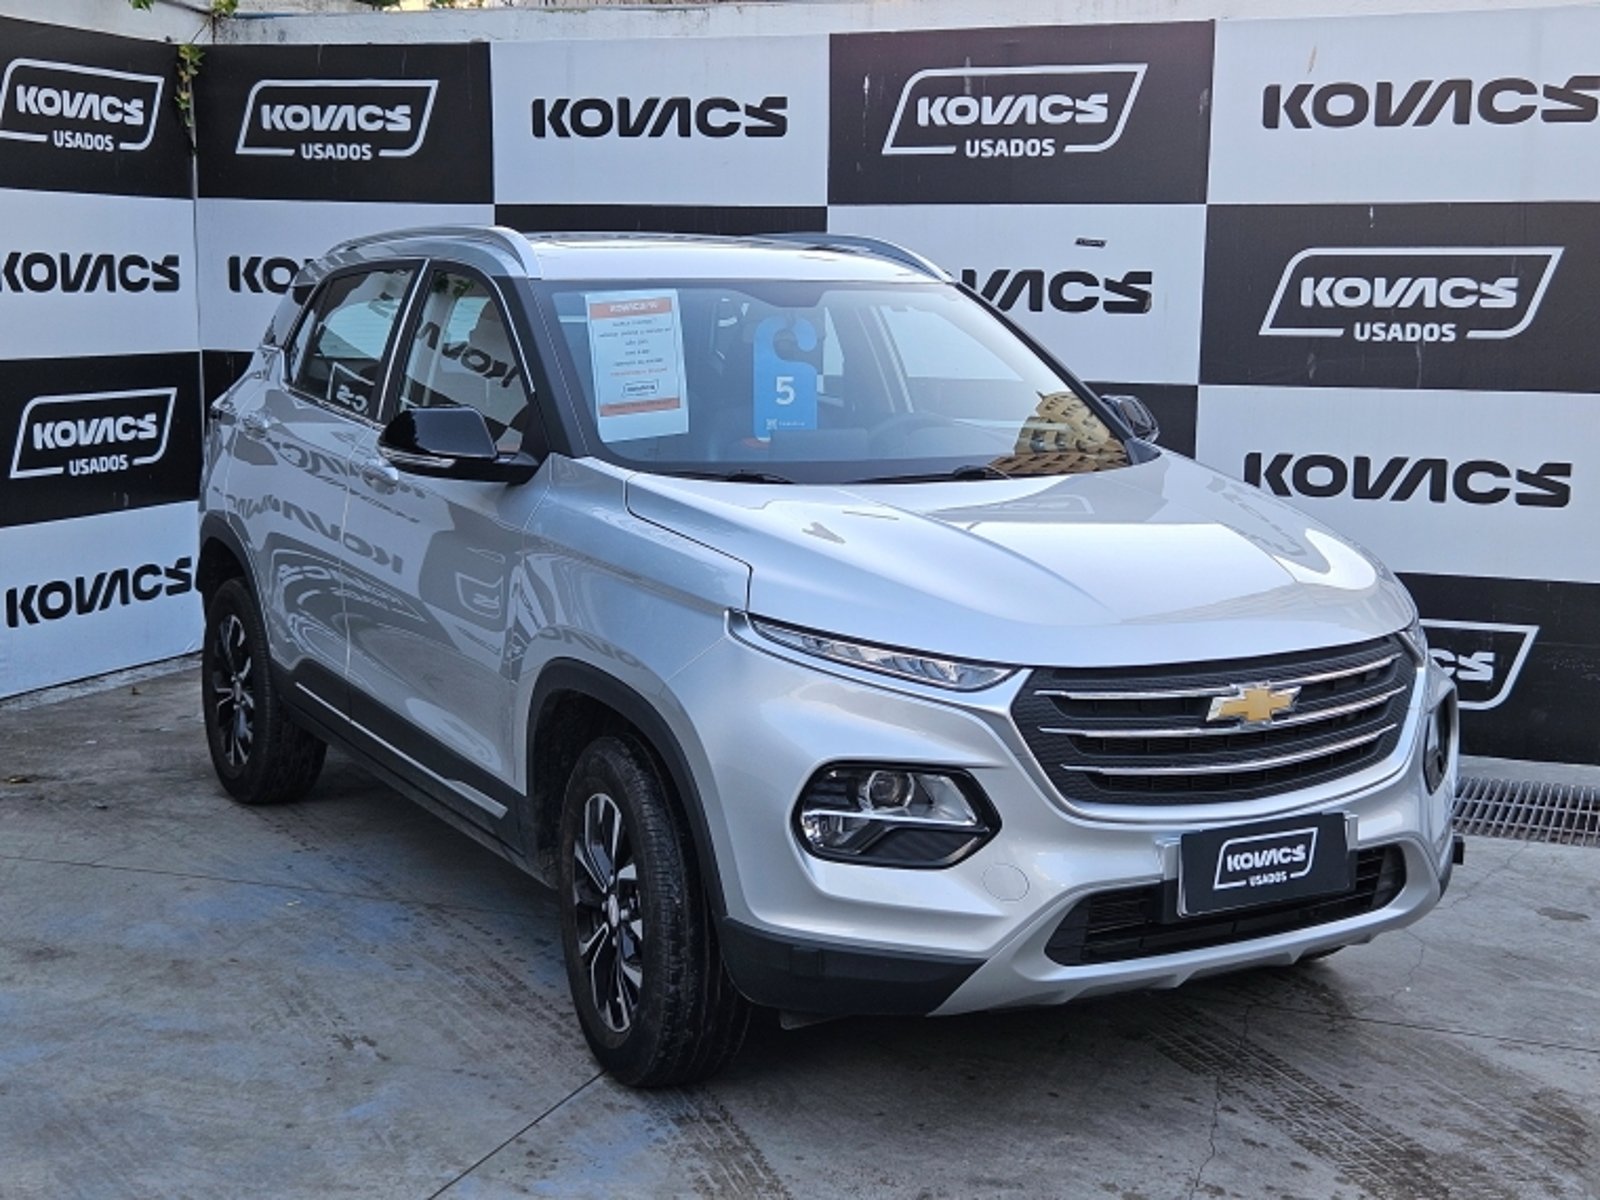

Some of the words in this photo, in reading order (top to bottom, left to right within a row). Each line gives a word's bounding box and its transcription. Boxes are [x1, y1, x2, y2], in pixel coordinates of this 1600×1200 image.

[16, 84, 145, 126] KOVACS
[532, 96, 788, 138] KOVACS
[917, 93, 1108, 127] KOVACS
[1262, 75, 1600, 129] KOVACS
[260, 104, 412, 132] KOVACS
[53, 130, 115, 152] USADOS
[301, 143, 373, 161] USADOS
[965, 138, 1056, 158] USADOS
[961, 269, 1153, 314] VACS
[1301, 277, 1519, 308] KOVACS
[1354, 322, 1456, 342] USADOS
[775, 376, 796, 406] 5
[33, 413, 157, 450] KOVACS
[69, 454, 128, 476] USADOS
[1243, 452, 1573, 508] KOVACS
[5, 556, 193, 629] KOVACS
[1226, 844, 1306, 872] KOVACS
